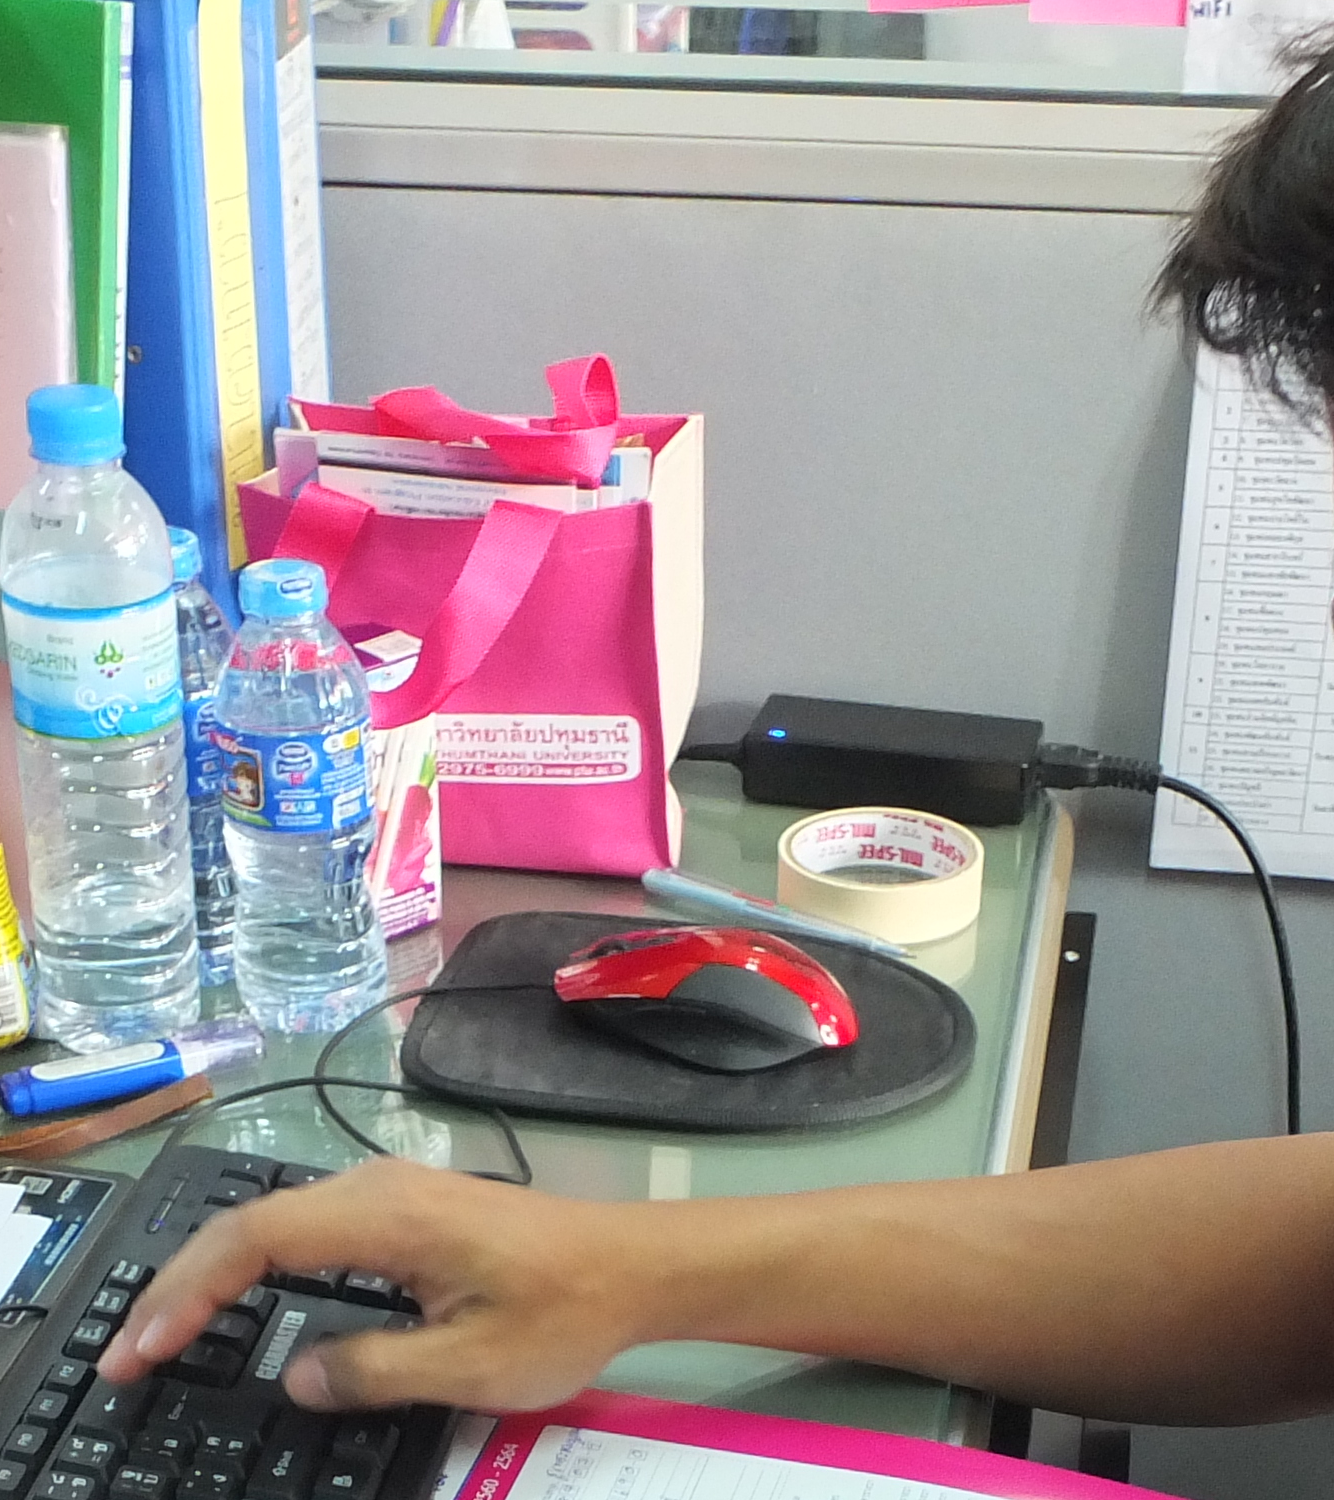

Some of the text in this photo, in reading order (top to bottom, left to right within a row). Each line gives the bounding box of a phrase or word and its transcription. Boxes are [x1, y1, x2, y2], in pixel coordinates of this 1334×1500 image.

[533, 750, 629, 762] UNIVERSITY
[255, 1310, 307, 1381] GEARMASTER
[493, 1443, 520, 1471] 2564
